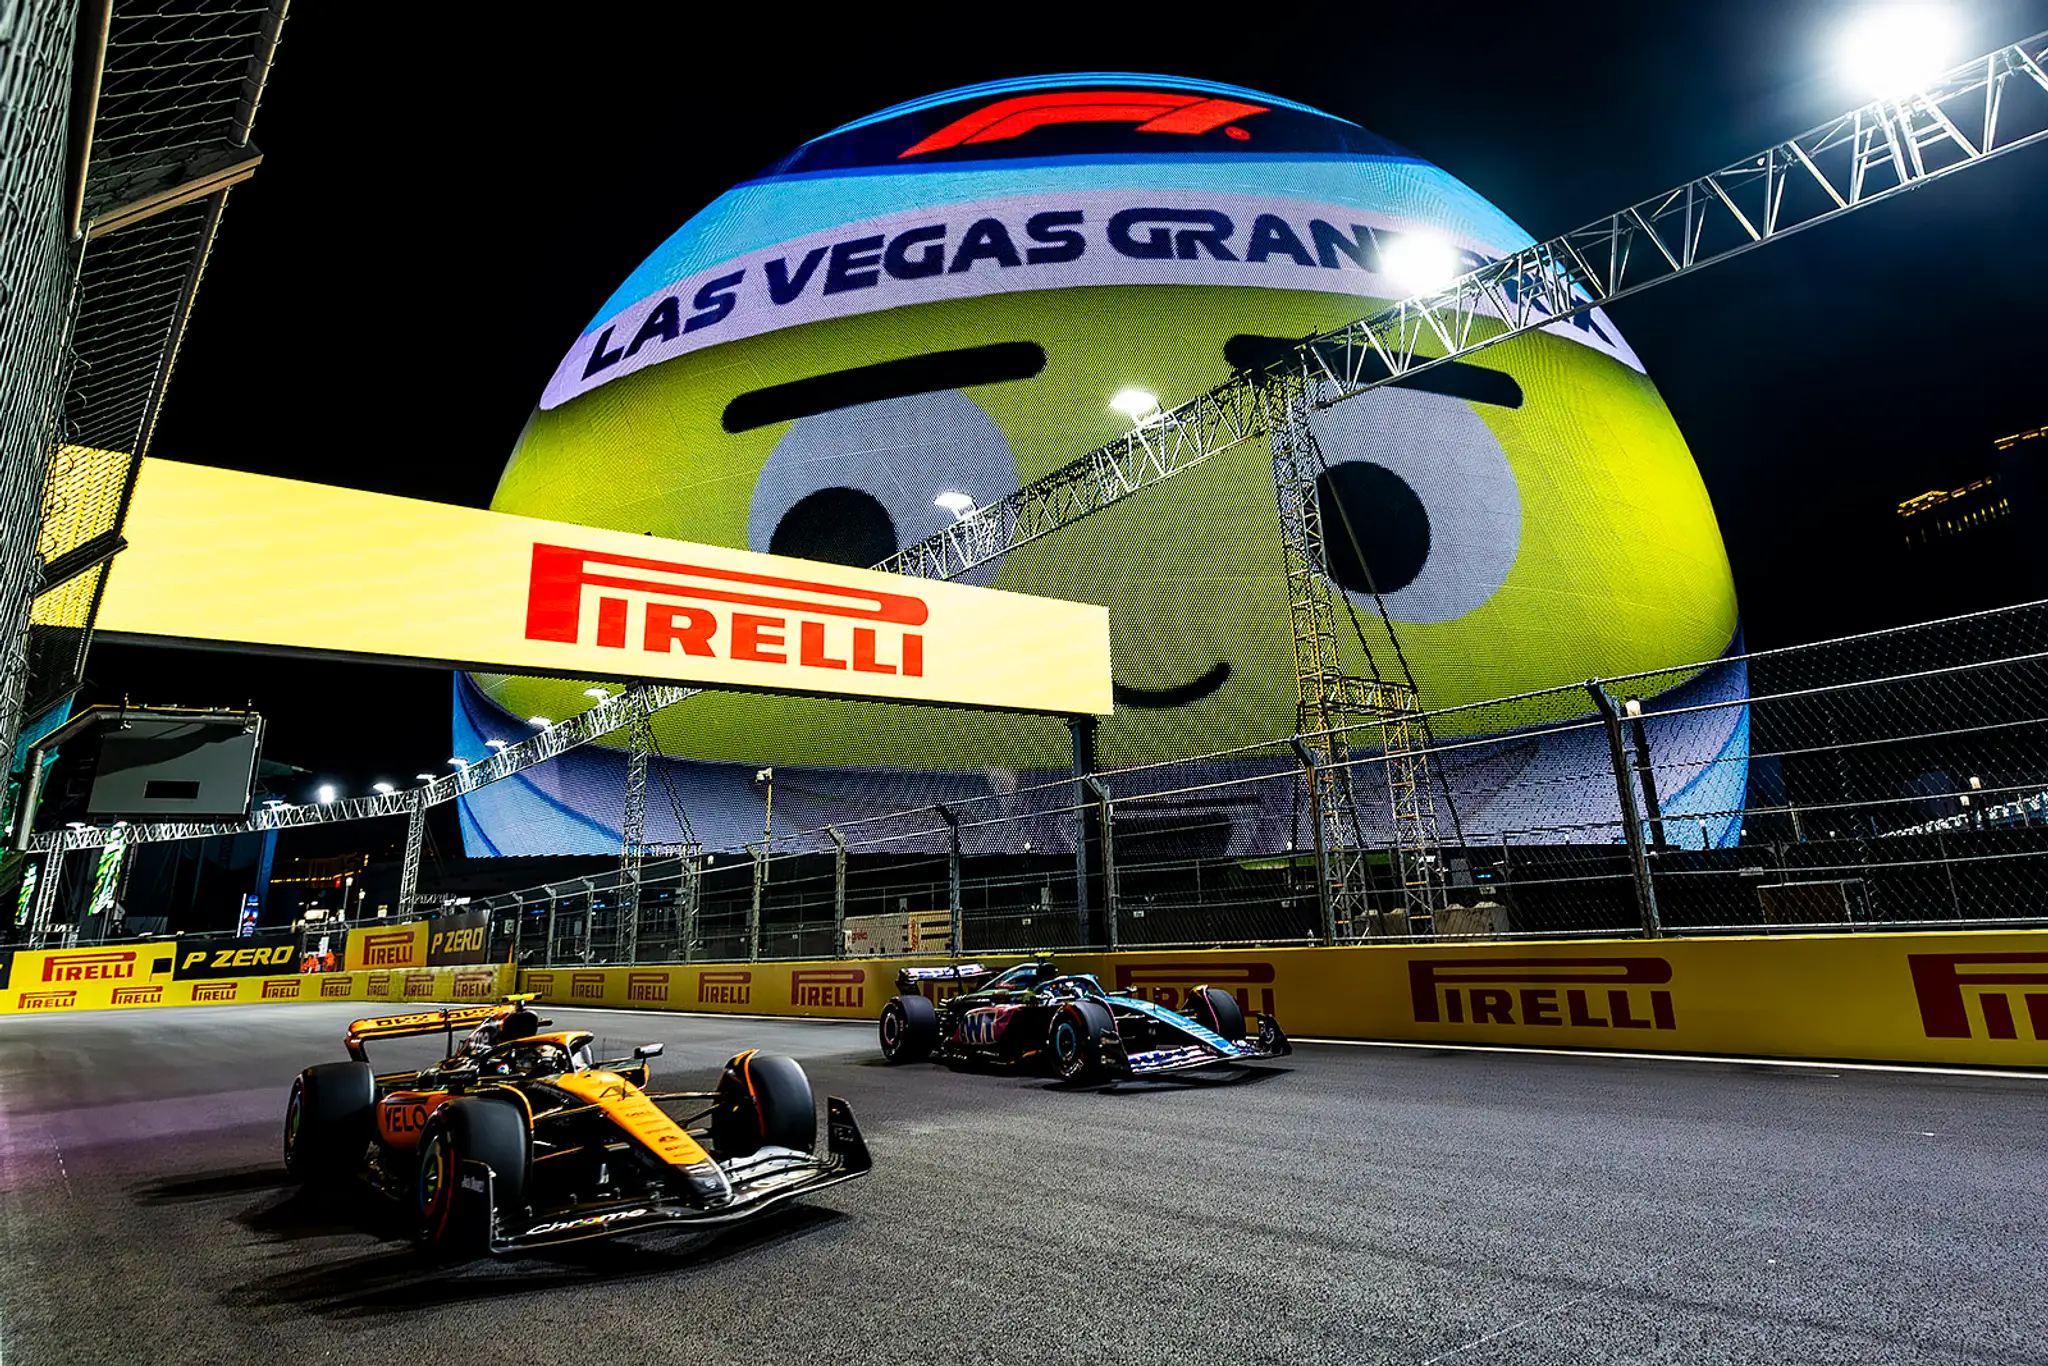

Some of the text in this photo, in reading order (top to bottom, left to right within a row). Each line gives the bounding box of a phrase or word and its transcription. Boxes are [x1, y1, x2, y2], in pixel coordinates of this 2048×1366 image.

[581, 269, 746, 382] LAS
[764, 210, 1084, 305] VEGAS
[525, 542, 929, 678] PIRELLI
[363, 931, 415, 965] PIRELLI
[431, 927, 484, 954] P ZERO
[42, 951, 137, 982] PIRELLI
[182, 945, 295, 970] P ZERO
[111, 985, 163, 1005] PIRELLI
[191, 982, 238, 1001] PIRELLI
[261, 979, 301, 998] PIRELLI
[320, 977, 352, 997] PIRELLI
[403, 974, 435, 996] PIRELLI
[571, 973, 605, 999] PIRELLI
[628, 972, 669, 1001] PIRELLI
[698, 972, 751, 1005] PIRELLI
[791, 970, 865, 1008] PIRELLI
[1408, 957, 1677, 1030] PIRELLI
[18, 990, 77, 1009] PIRELLI
[386, 1105, 428, 1132] VELO
